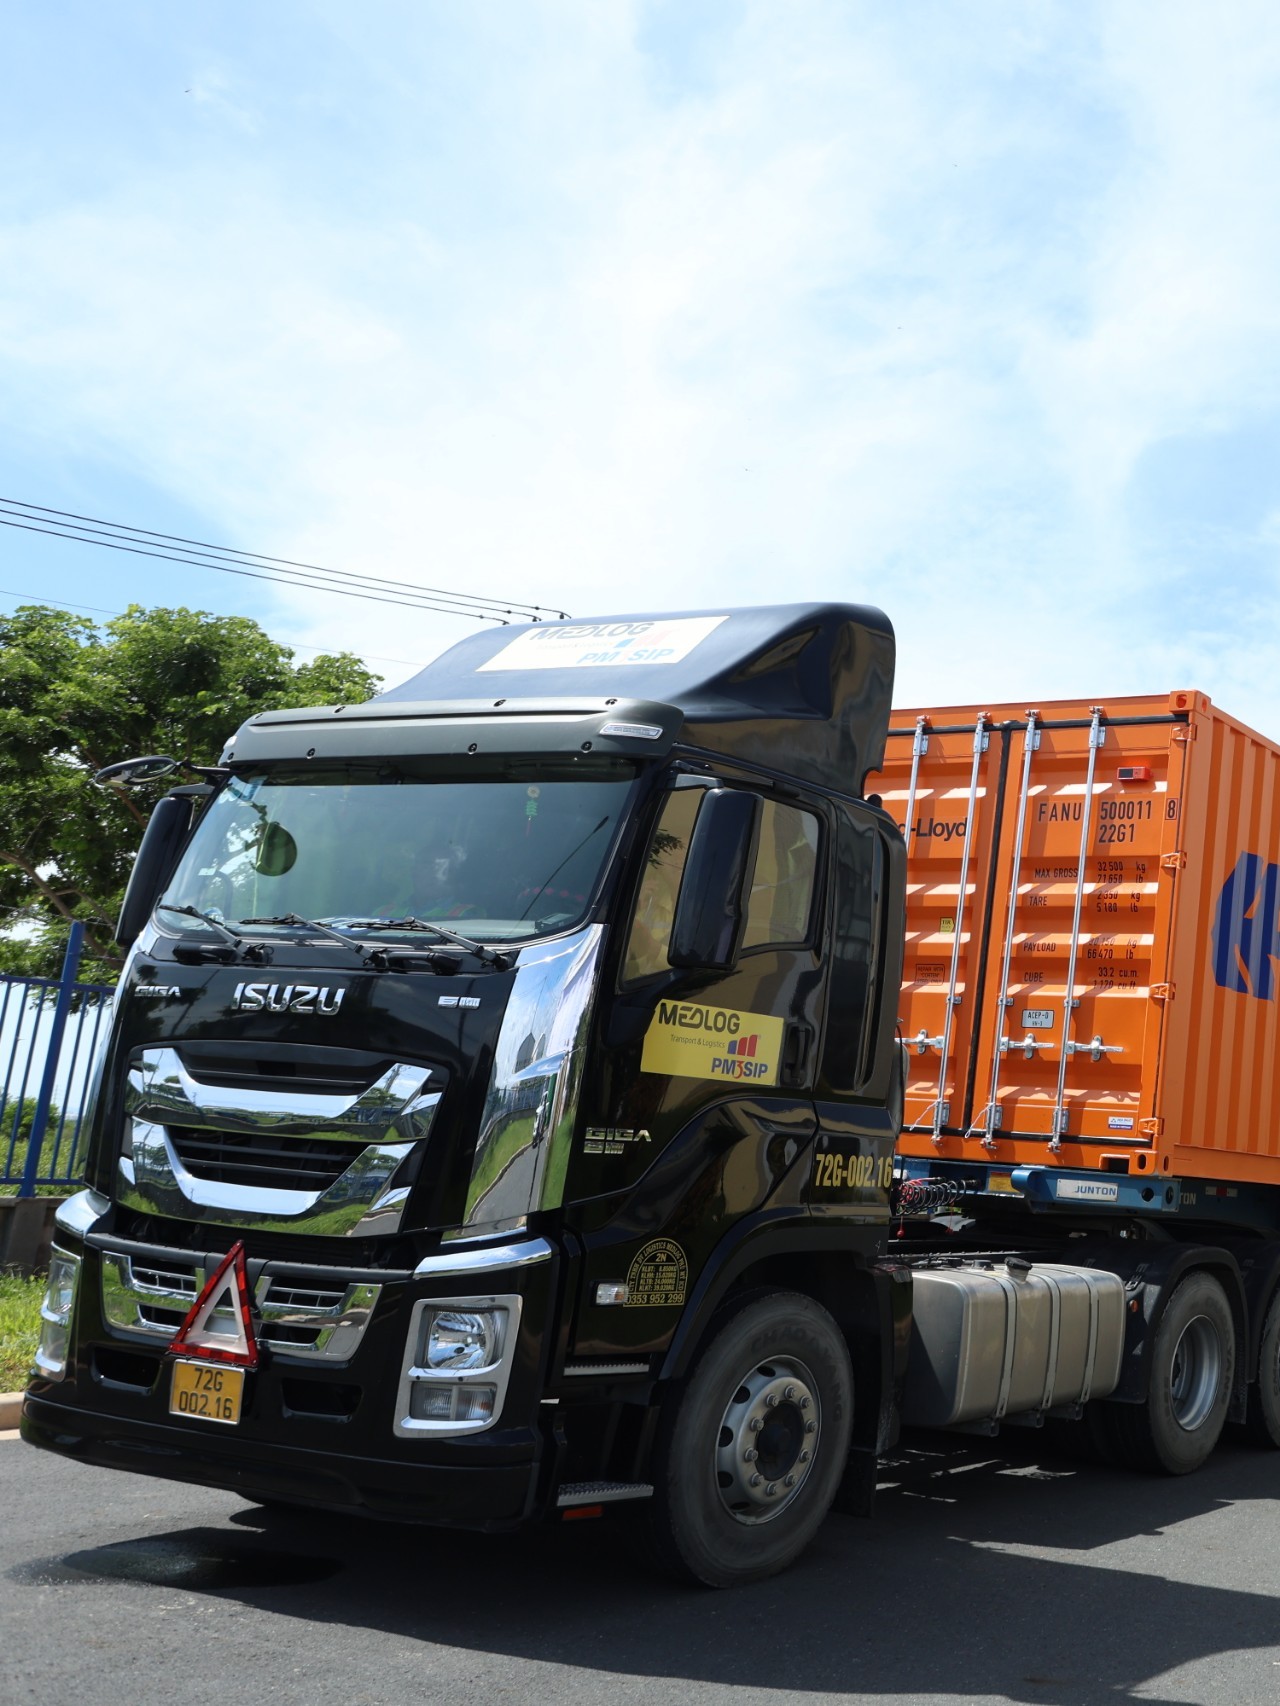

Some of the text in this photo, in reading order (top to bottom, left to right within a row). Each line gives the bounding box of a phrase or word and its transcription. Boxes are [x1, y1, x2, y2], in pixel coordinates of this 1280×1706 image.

[529, 622, 655, 641] MEDLOG
[1038, 800, 1176, 822] FANU 500011 8
[1098, 823, 1135, 843] 22G1
[1135, 861, 1146, 873] kg
[1034, 868, 1078, 878] MAX GROSS
[1135, 874, 1144, 883] lb
[1029, 896, 1048, 906] TARE
[1130, 891, 1141, 902] kg
[1130, 903, 1139, 913] lb
[1023, 942, 1056, 952] PAYLOAD
[1125, 949, 1134, 960] lb
[1023, 972, 1044, 982] CUBE
[1098, 967, 1115, 977] 33.2
[134, 985, 182, 998] GIGA
[231, 982, 347, 1016] ISUZU
[658, 1002, 741, 1035] MEDLOG
[671, 1034, 697, 1045] Transport
[702, 1038, 726, 1049] Logistics
[585, 1127, 652, 1142] GIGA
[815, 1153, 893, 1189] 72G-002.16
[1074, 1186, 1116, 1197] JUNTON
[655, 1253, 667, 1262] 2N
[649, 1293, 666, 1304] 952
[667, 1293, 683, 1303] 299
[194, 1367, 224, 1392] 72G
[178, 1391, 233, 1419] 002.16
